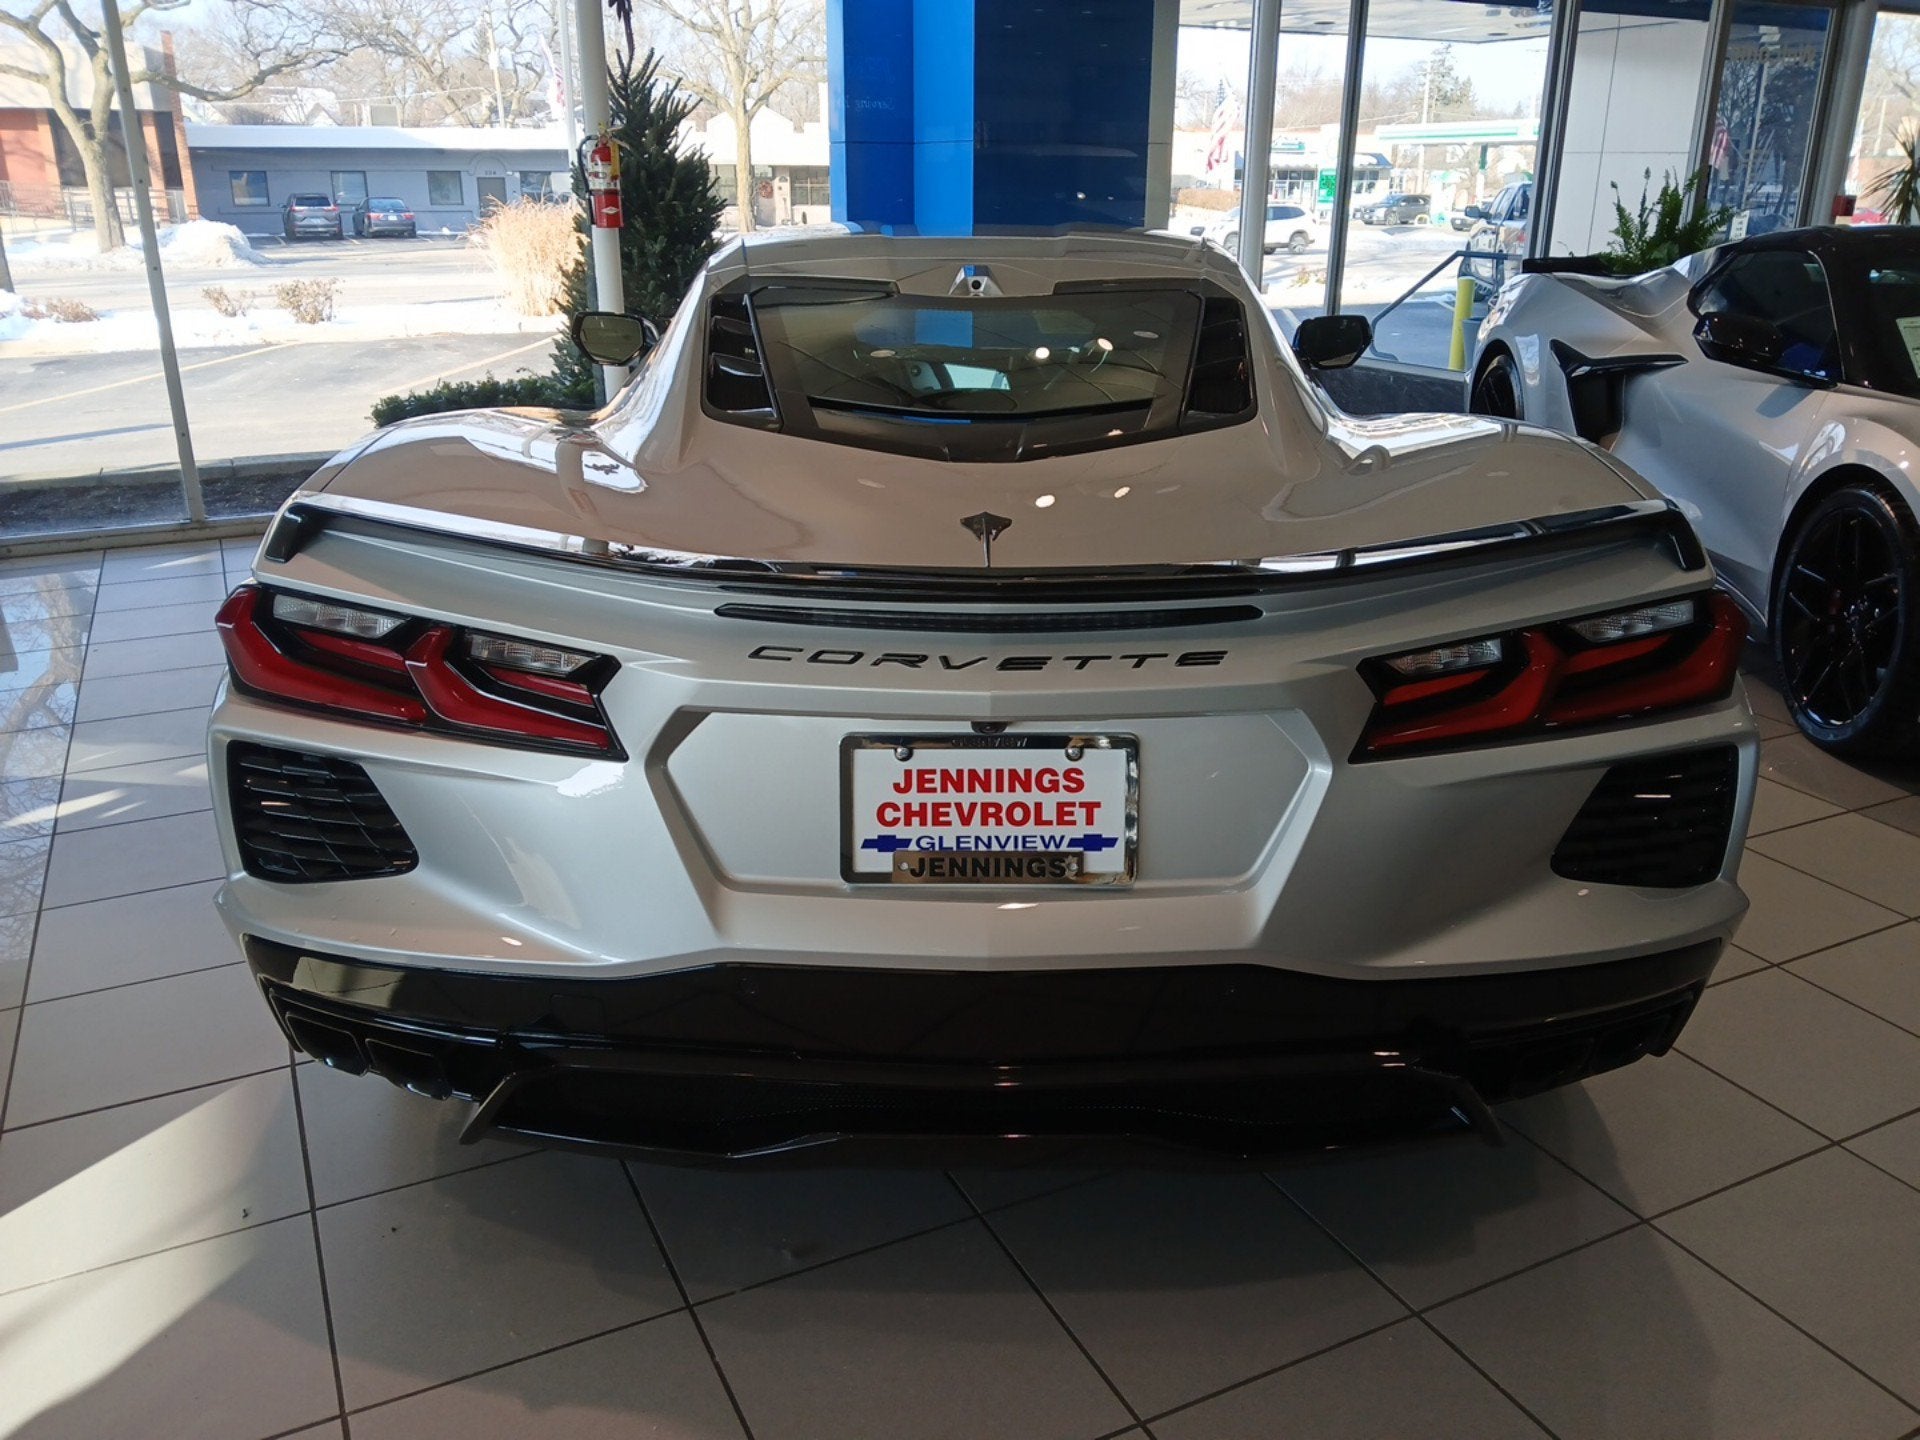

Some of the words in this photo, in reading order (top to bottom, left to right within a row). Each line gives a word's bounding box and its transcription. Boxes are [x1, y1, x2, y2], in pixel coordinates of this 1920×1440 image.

[747, 645, 1229, 671] CORVETTE
[893, 768, 1085, 794] JENNINGS
[876, 801, 1102, 827] CHEVROLET
[915, 835, 1066, 851] GLENVIEW
[909, 857, 1067, 878] JENNINGS
